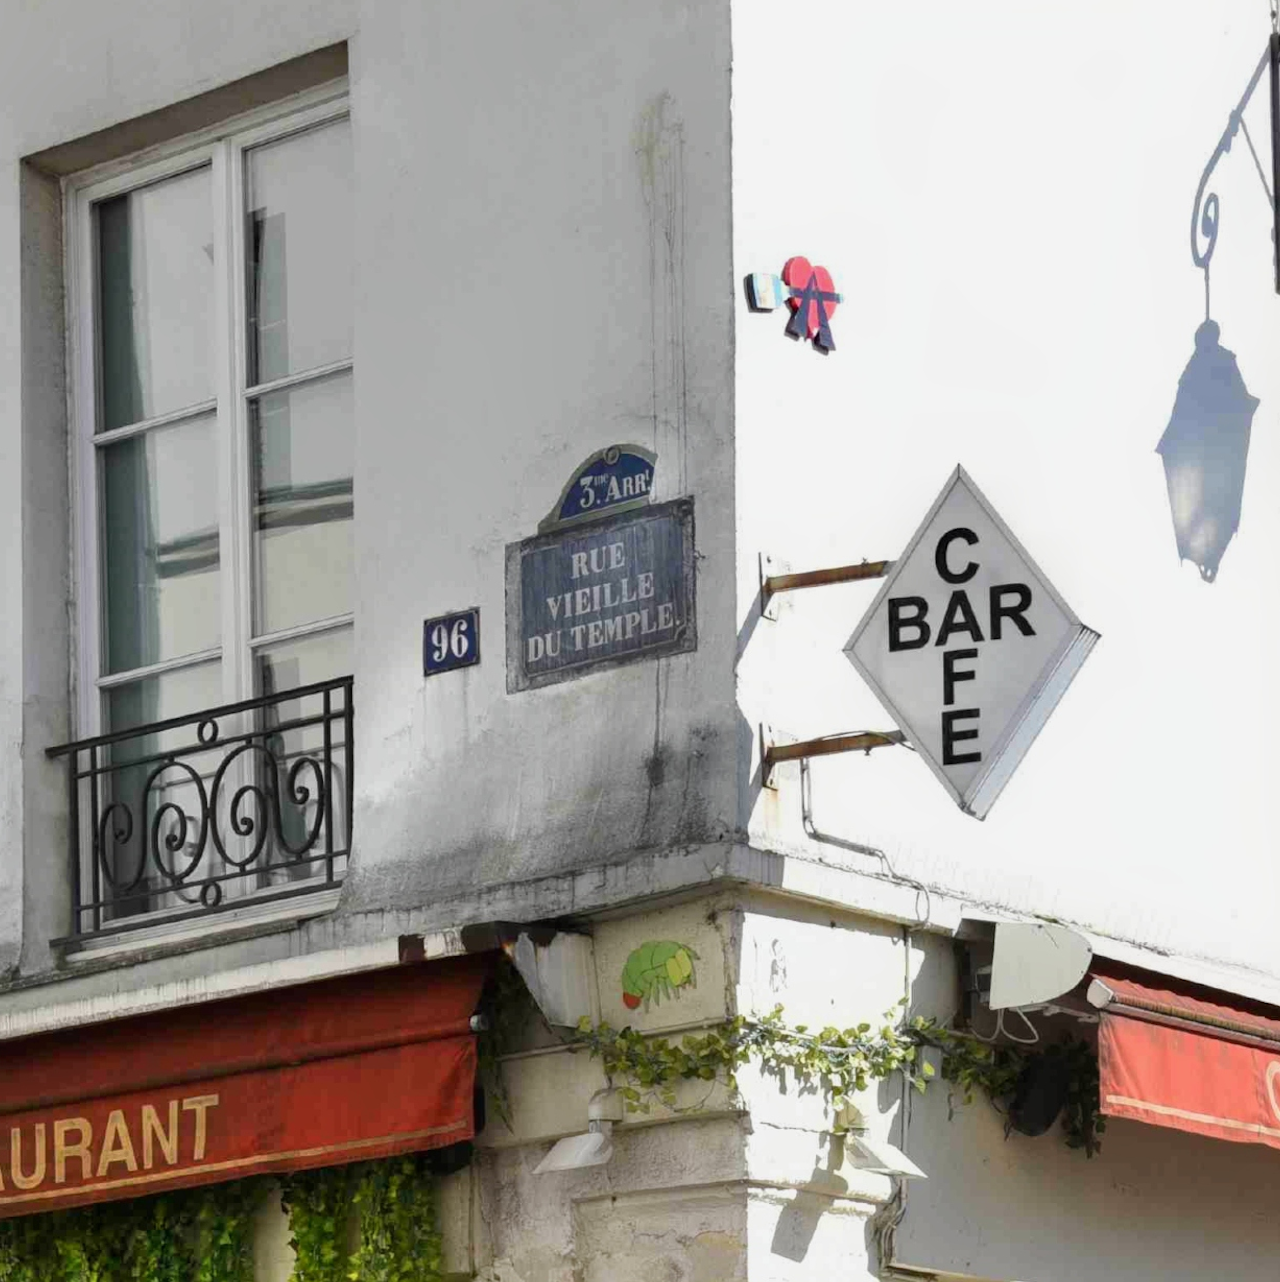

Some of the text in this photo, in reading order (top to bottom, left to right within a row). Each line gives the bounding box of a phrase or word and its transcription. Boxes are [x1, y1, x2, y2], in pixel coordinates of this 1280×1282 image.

[571, 542, 625, 579] RUE
[547, 571, 654, 620] VIEILLE
[887, 583, 1037, 652] BAR
[431, 618, 469, 662] 96
[528, 630, 562, 662] DU
